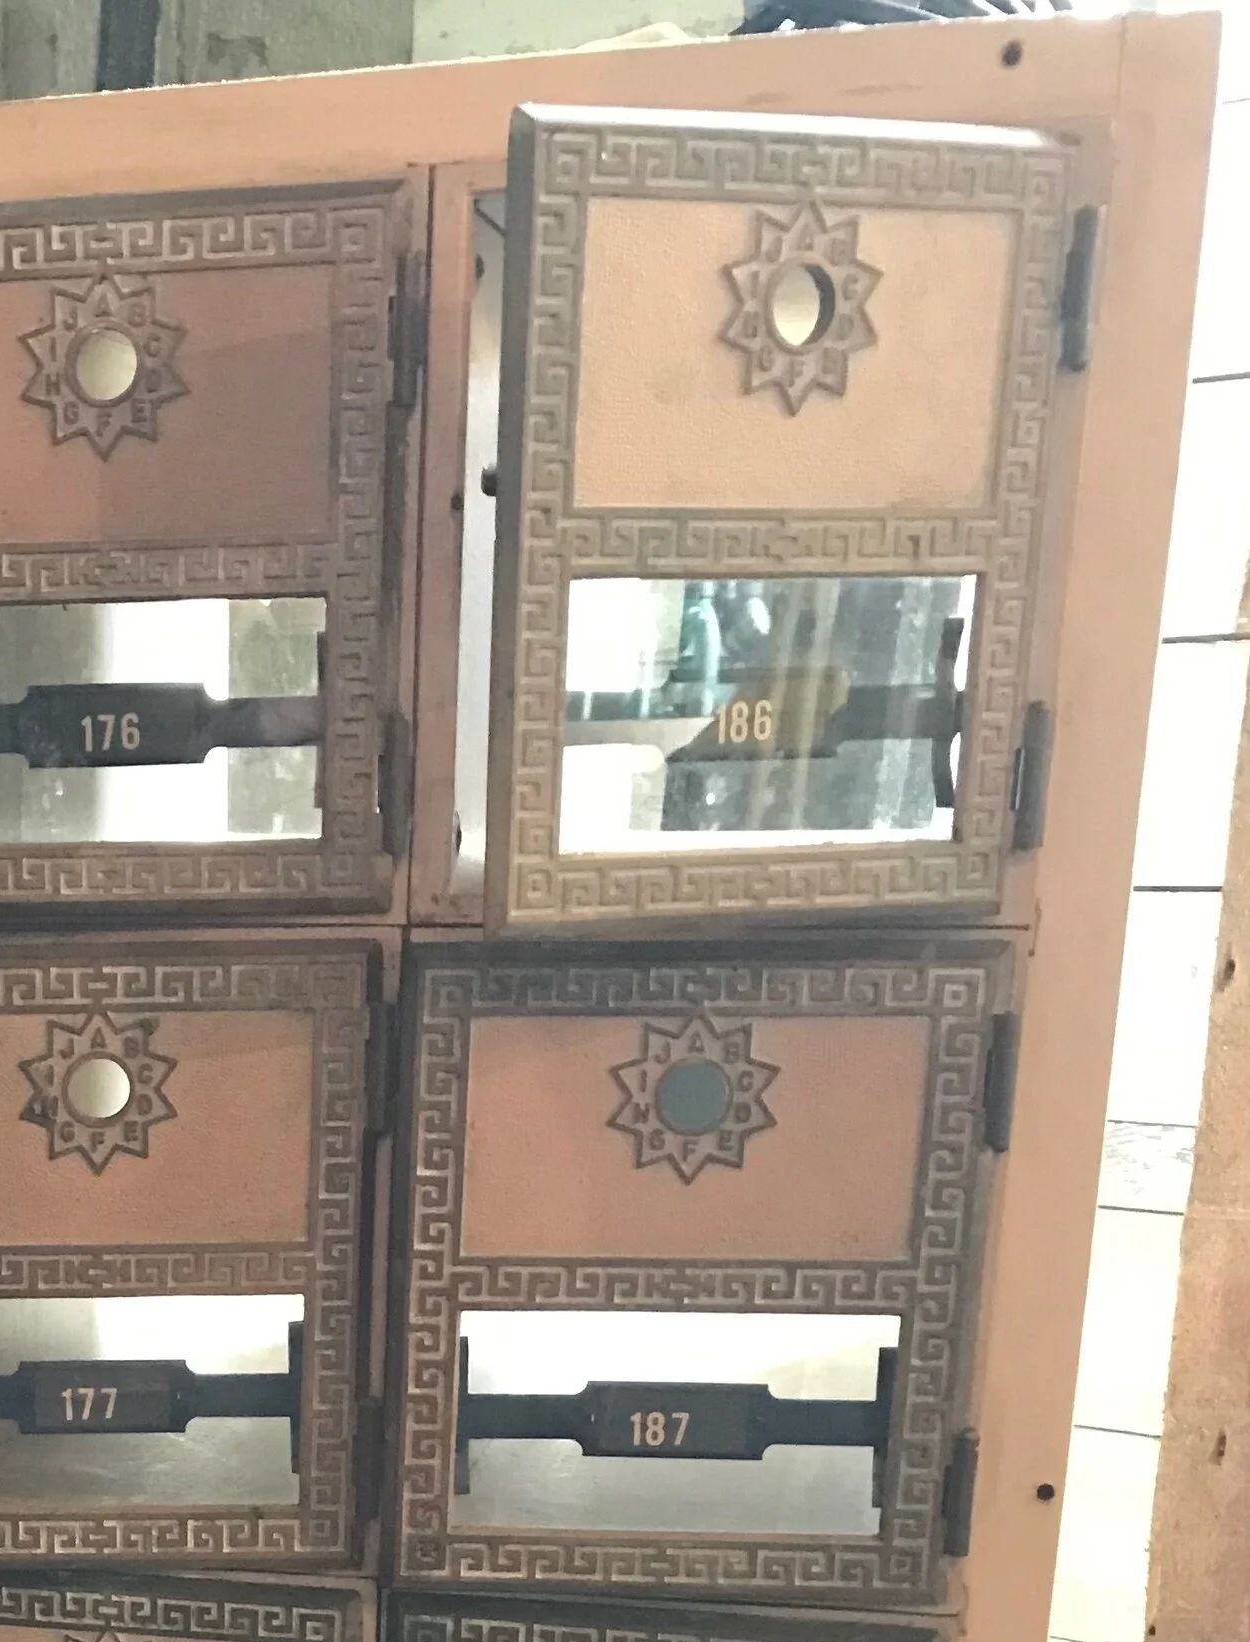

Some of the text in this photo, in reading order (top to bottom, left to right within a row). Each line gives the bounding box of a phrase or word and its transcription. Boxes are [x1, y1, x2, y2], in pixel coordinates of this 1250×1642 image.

[81, 713, 140, 752] 176
[715, 700, 772, 744] 186
[61, 1388, 117, 1421] 177
[630, 1411, 689, 1446] 187
